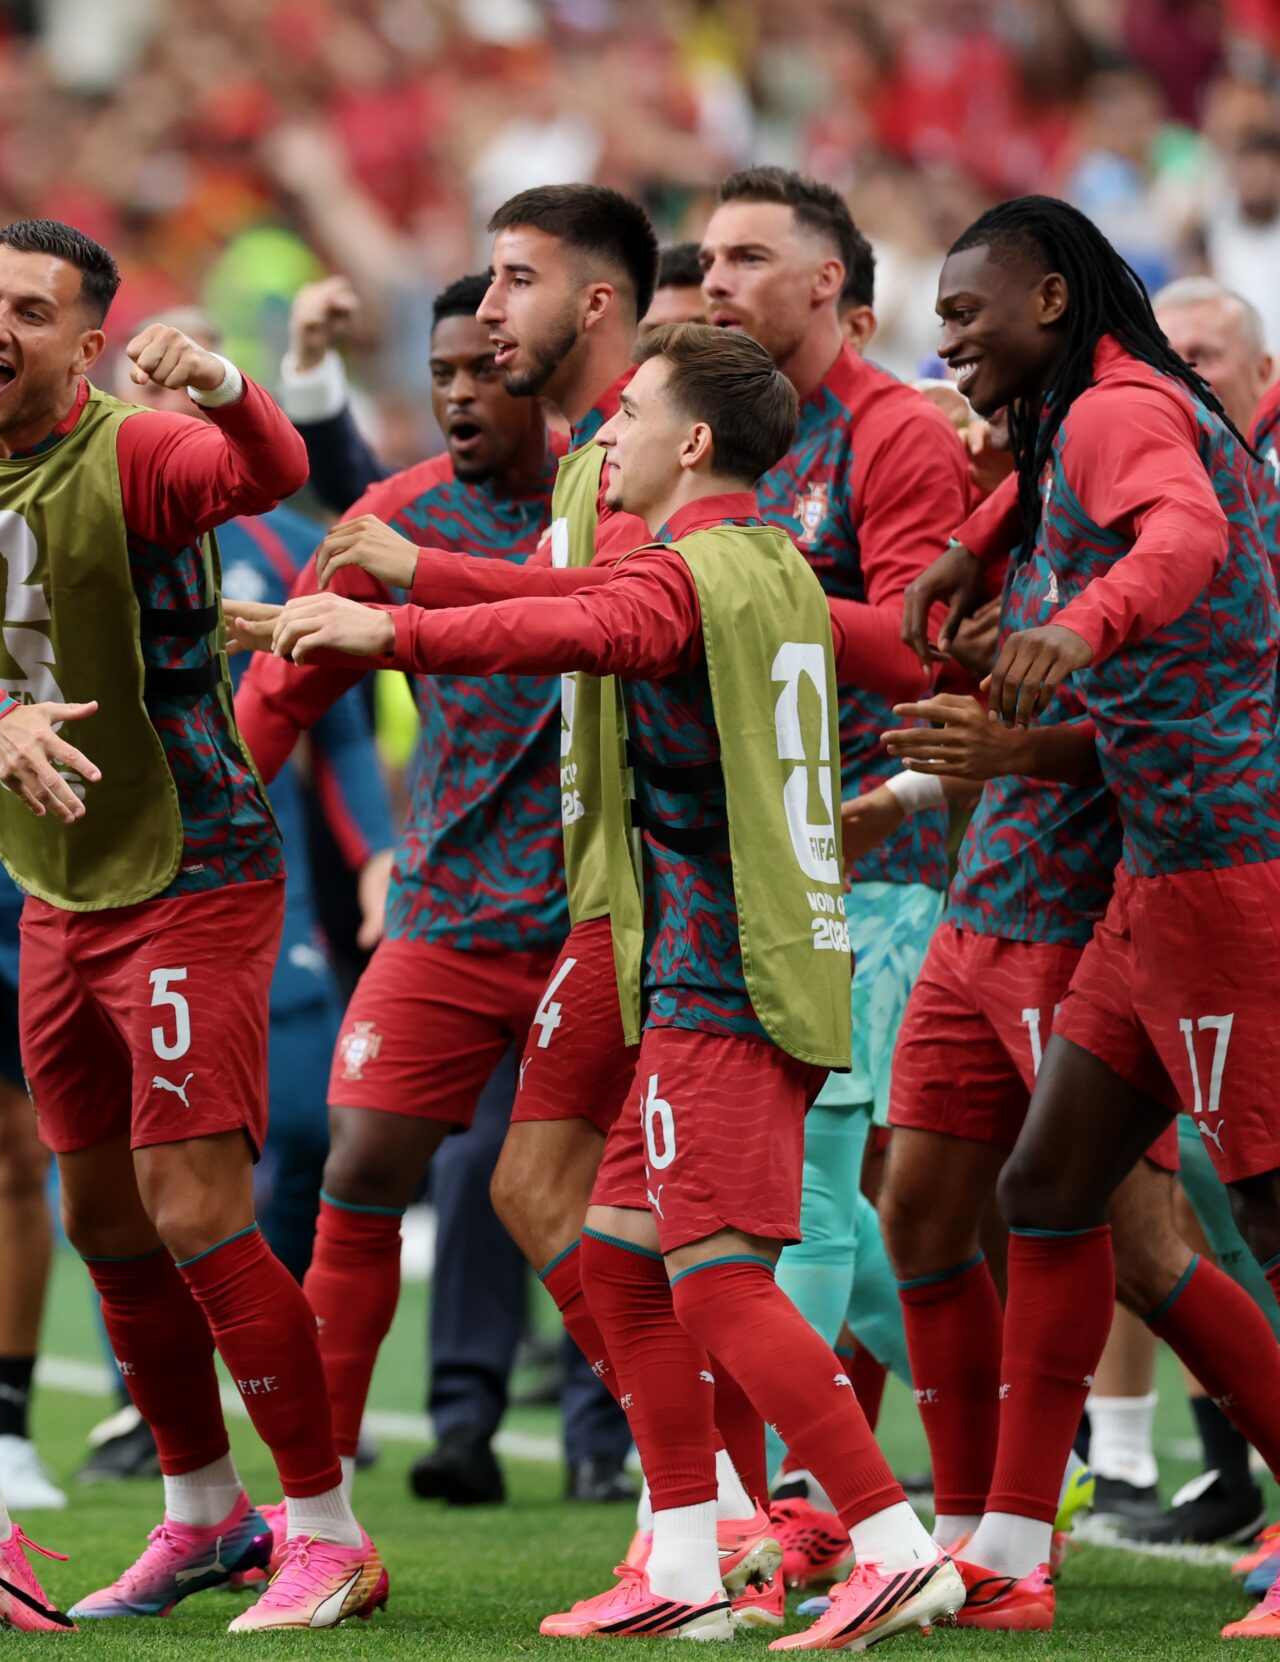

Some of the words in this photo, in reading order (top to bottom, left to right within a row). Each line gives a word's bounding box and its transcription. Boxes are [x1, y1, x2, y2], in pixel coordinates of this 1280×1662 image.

[808, 837, 837, 861] FIFA
[148, 967, 191, 1061] 5
[533, 957, 578, 1048] 4
[1179, 1012, 1234, 1113] 17
[645, 1073, 676, 1170] 6
